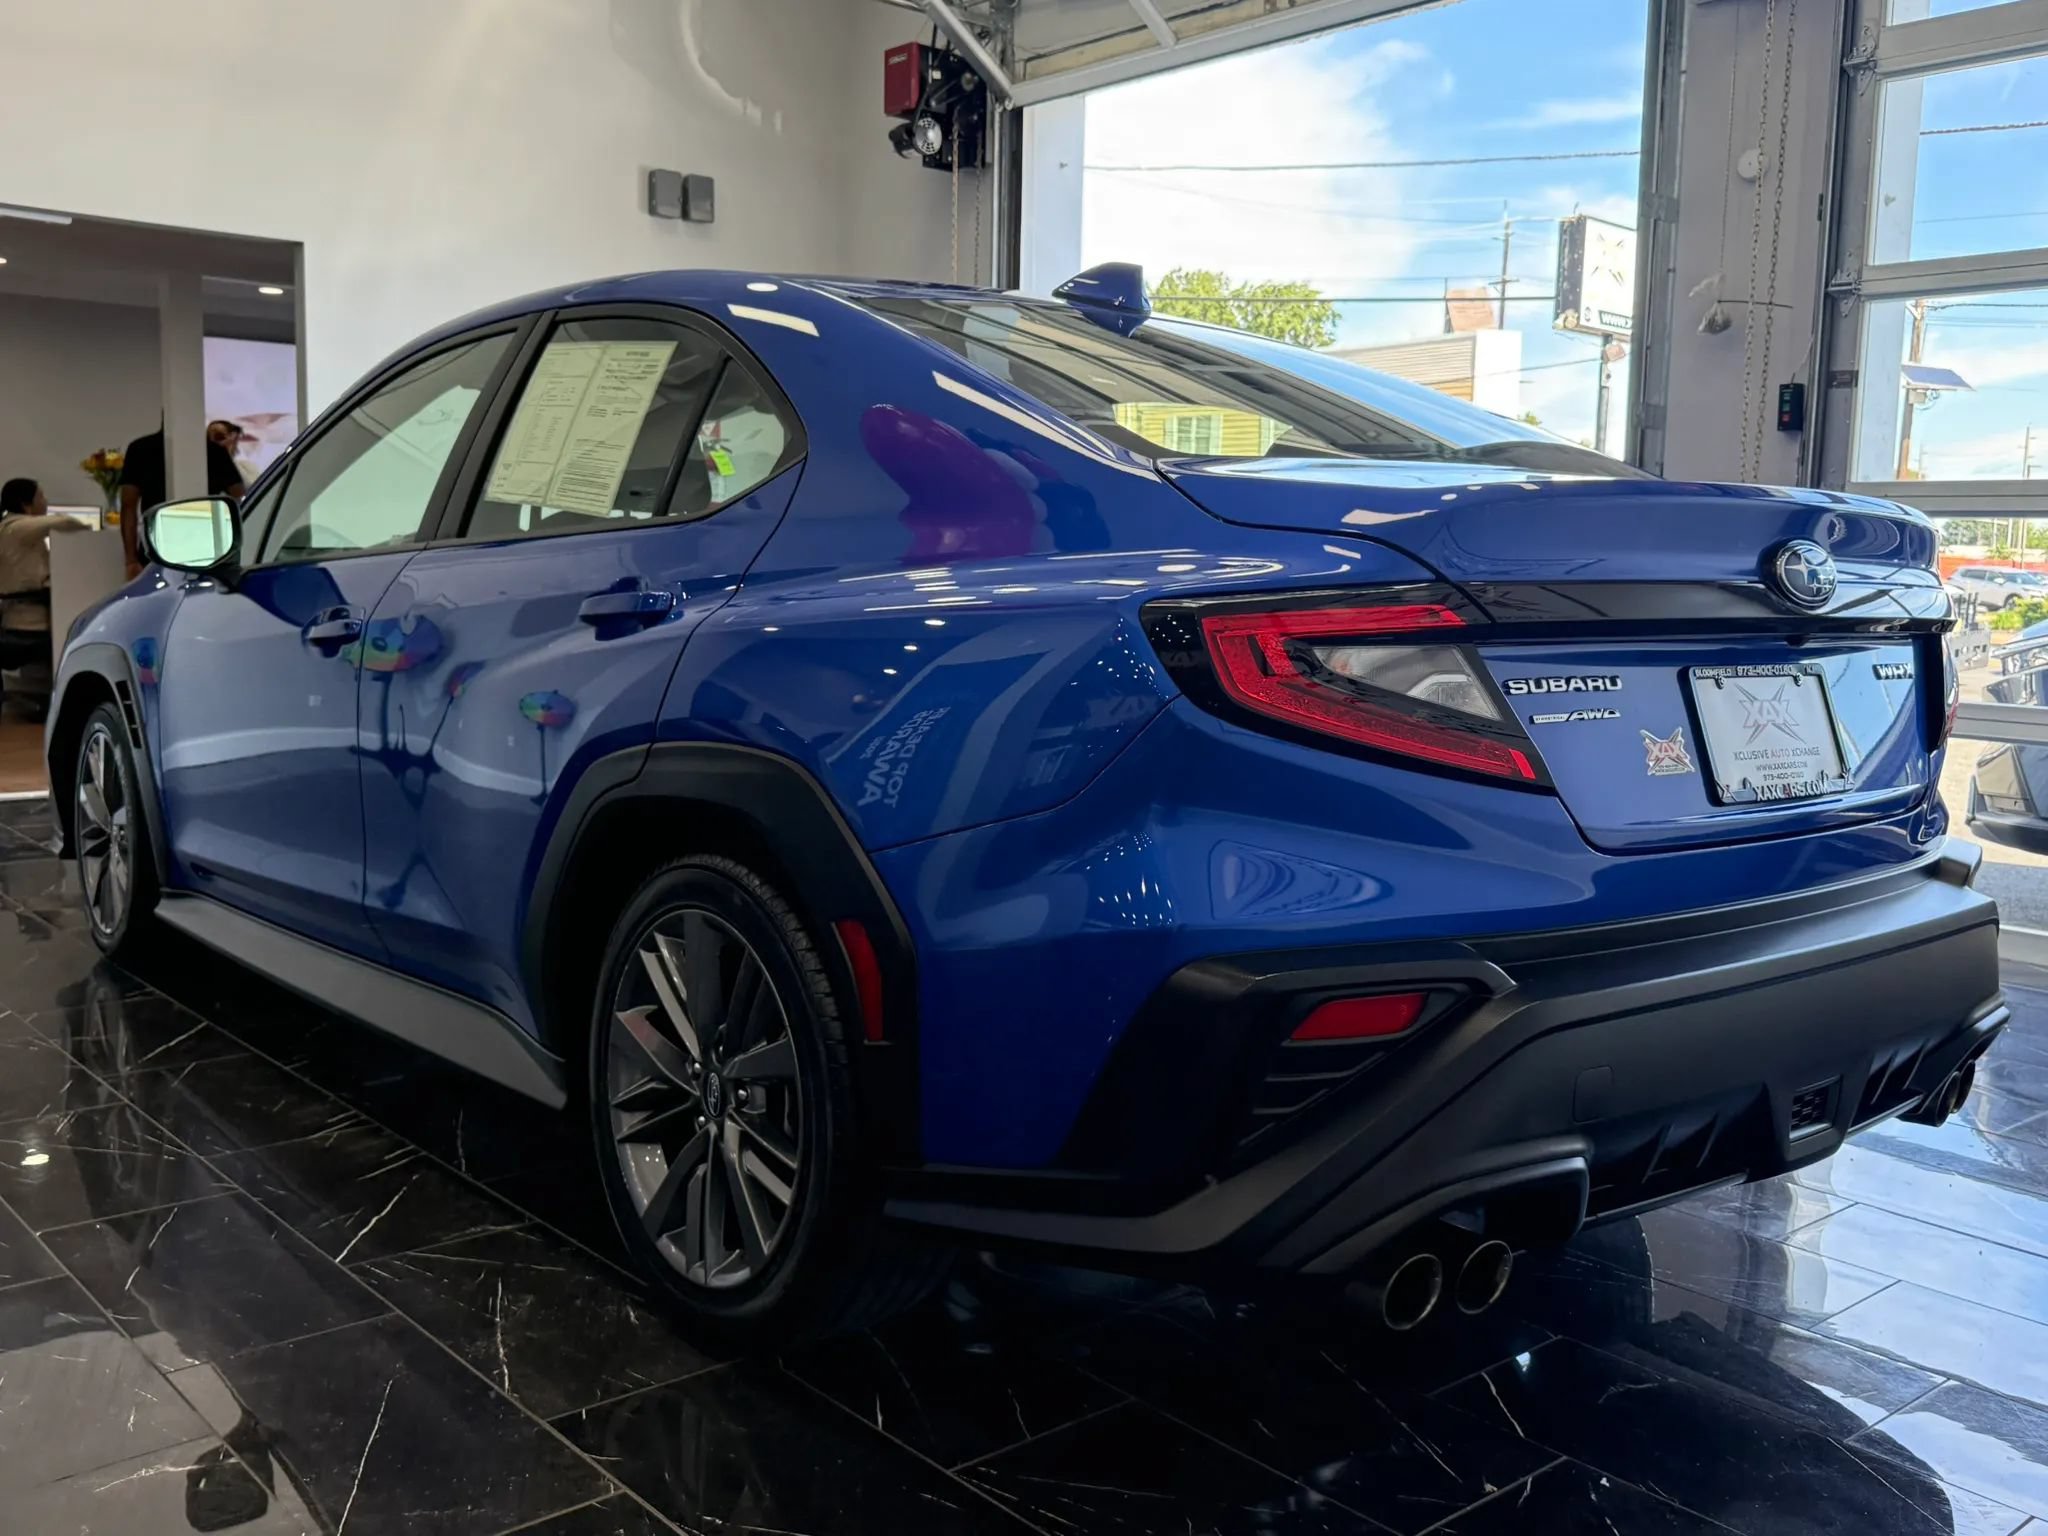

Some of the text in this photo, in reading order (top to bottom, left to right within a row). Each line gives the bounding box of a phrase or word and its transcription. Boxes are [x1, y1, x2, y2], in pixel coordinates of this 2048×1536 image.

[1503, 676, 1622, 695] SUBARU
[1568, 709, 1621, 721] AWD
[1739, 699, 1800, 728] XAX
[1733, 750, 1769, 761] XCLUSIVE
[1770, 748, 1791, 759] AUTO
[1755, 779, 1829, 801] XAXCARS.COM
